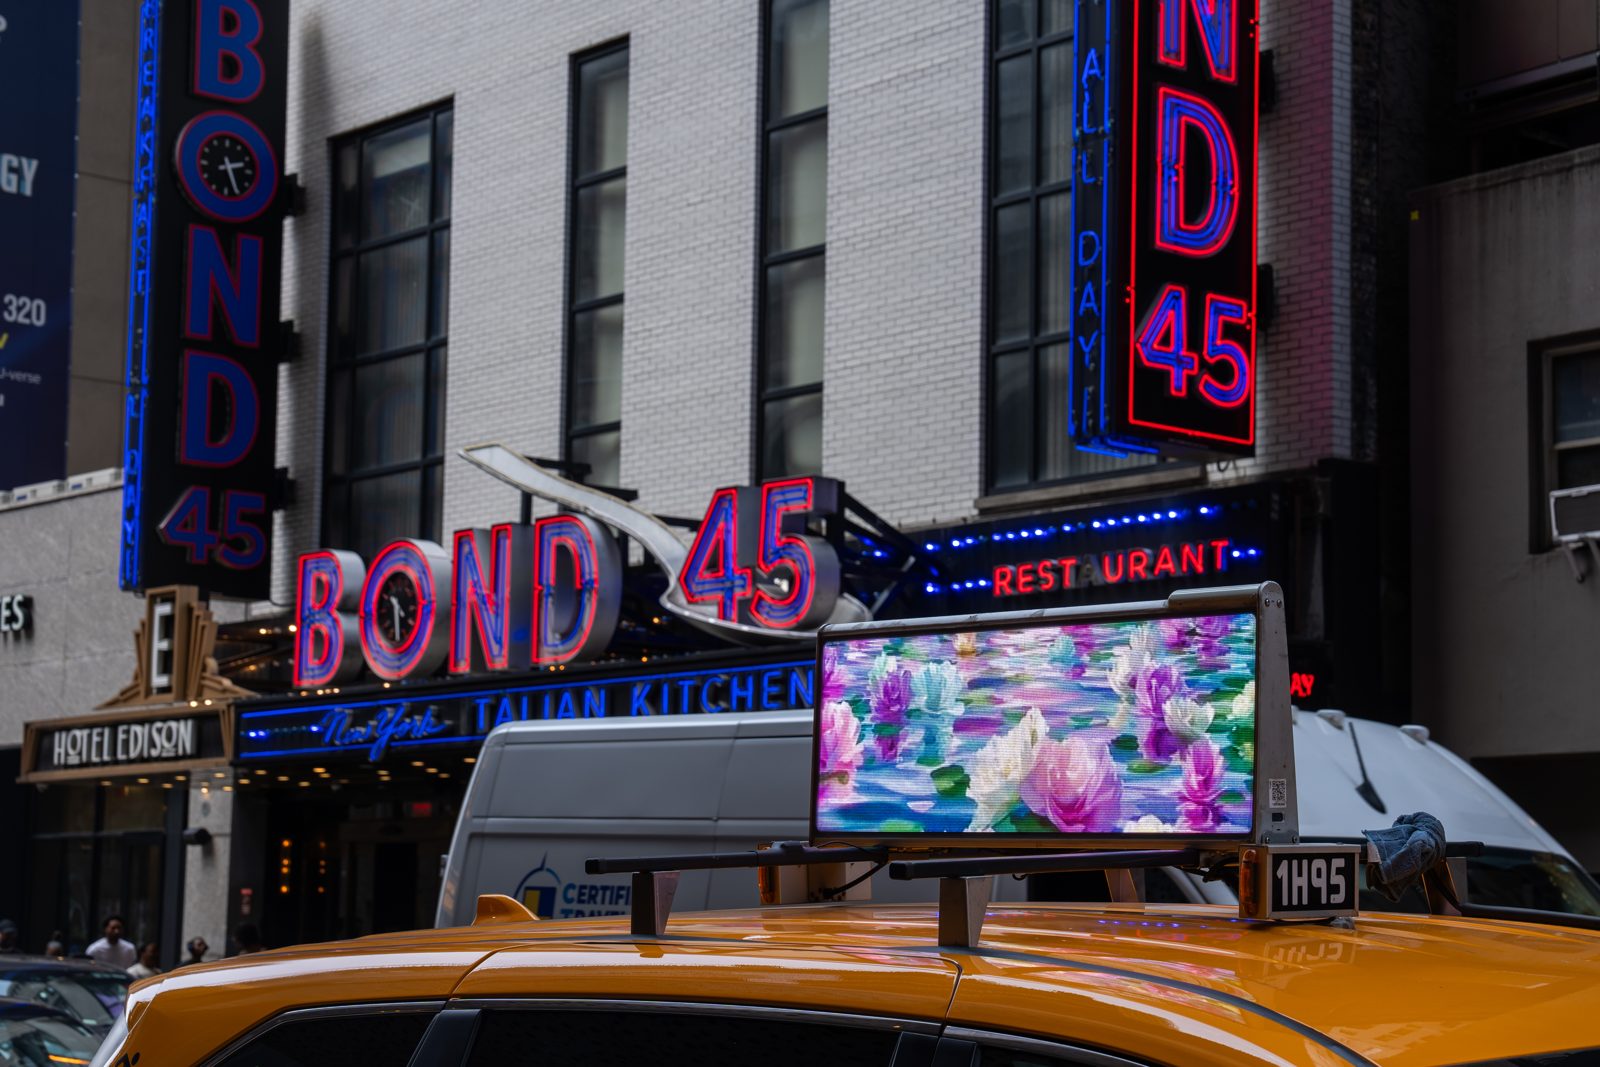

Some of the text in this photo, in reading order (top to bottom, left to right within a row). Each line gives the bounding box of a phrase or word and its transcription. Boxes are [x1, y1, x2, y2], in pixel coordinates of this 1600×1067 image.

[1081, 47, 1104, 184] ALL
[177, 0, 280, 468] BOND
[3, 293, 46, 327] 320
[1136, 285, 1252, 408] 45
[158, 486, 267, 570] 45
[293, 476, 820, 688] BOND 45
[993, 539, 1230, 598] RESTAURANT
[150, 600, 173, 690] E
[630, 668, 815, 717] KITCHEN
[53, 718, 193, 765] HOTEL EDISON
[368, 703, 449, 762] York
[1276, 857, 1347, 907] 1H95
